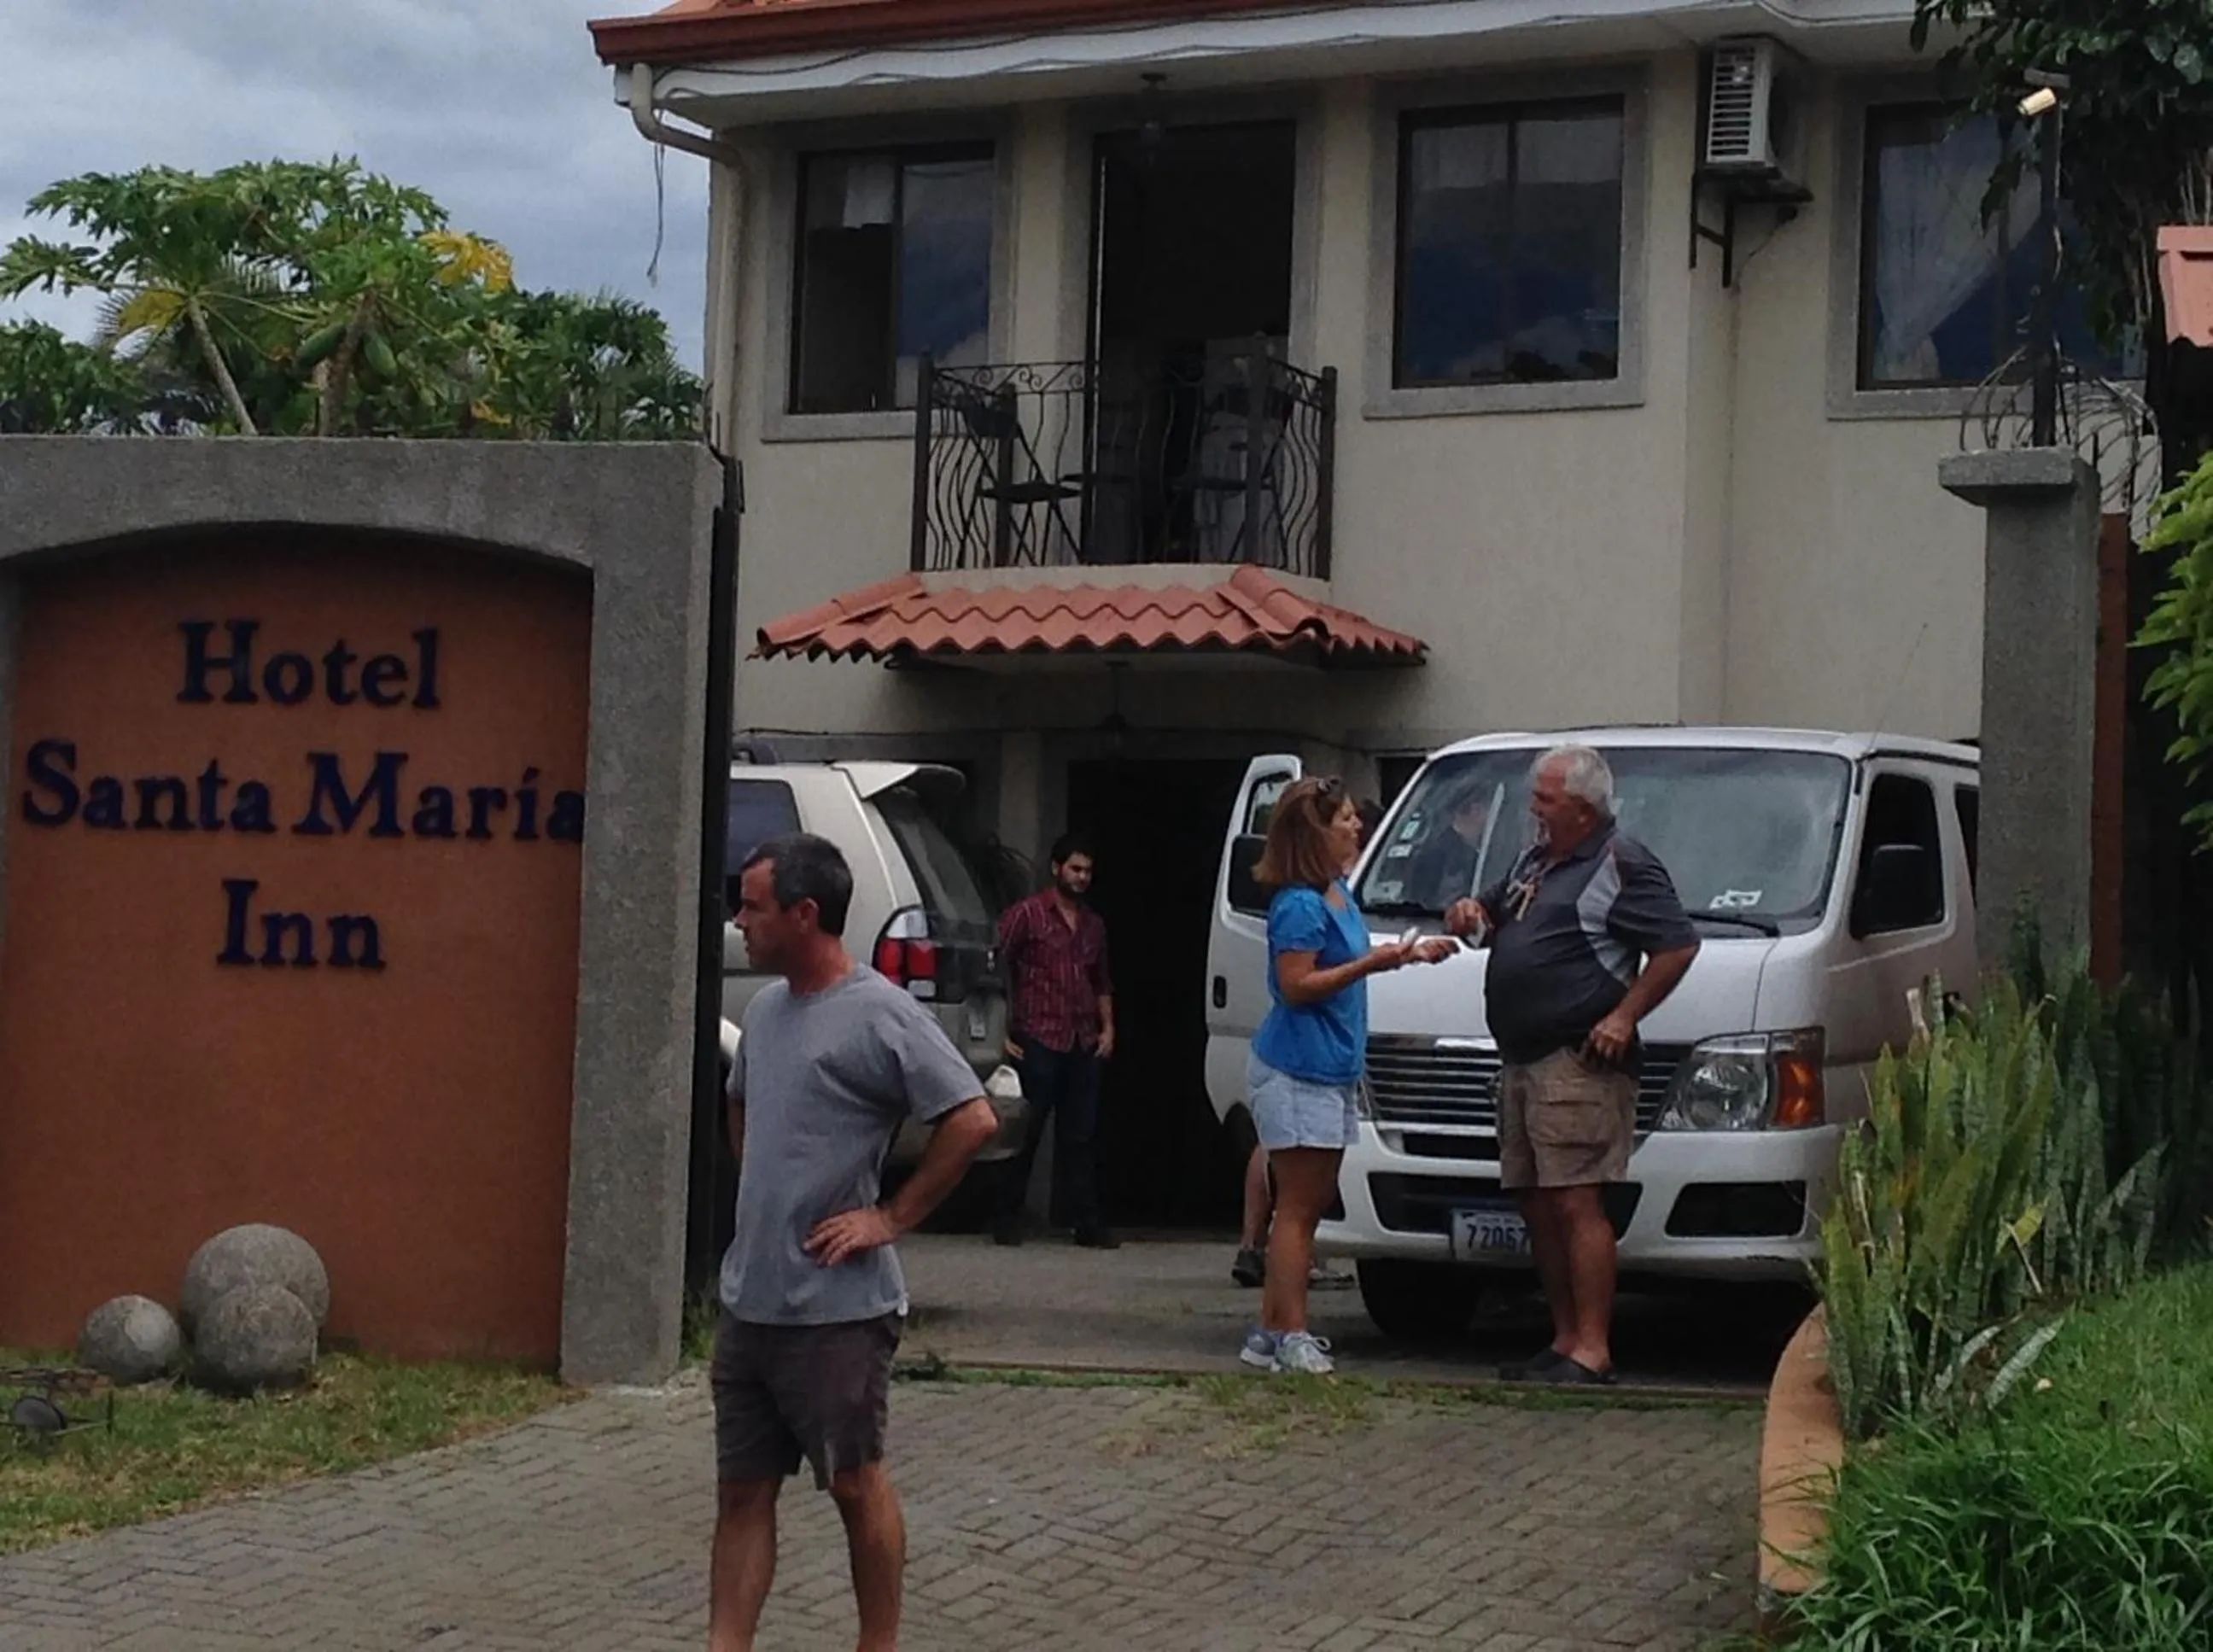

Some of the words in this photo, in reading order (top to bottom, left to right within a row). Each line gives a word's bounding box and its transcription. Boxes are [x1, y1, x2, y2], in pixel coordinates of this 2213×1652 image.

[177, 620, 441, 709] Hotel
[23, 738, 277, 834] Santa
[291, 751, 584, 844] María
[216, 879, 387, 970] Inn
